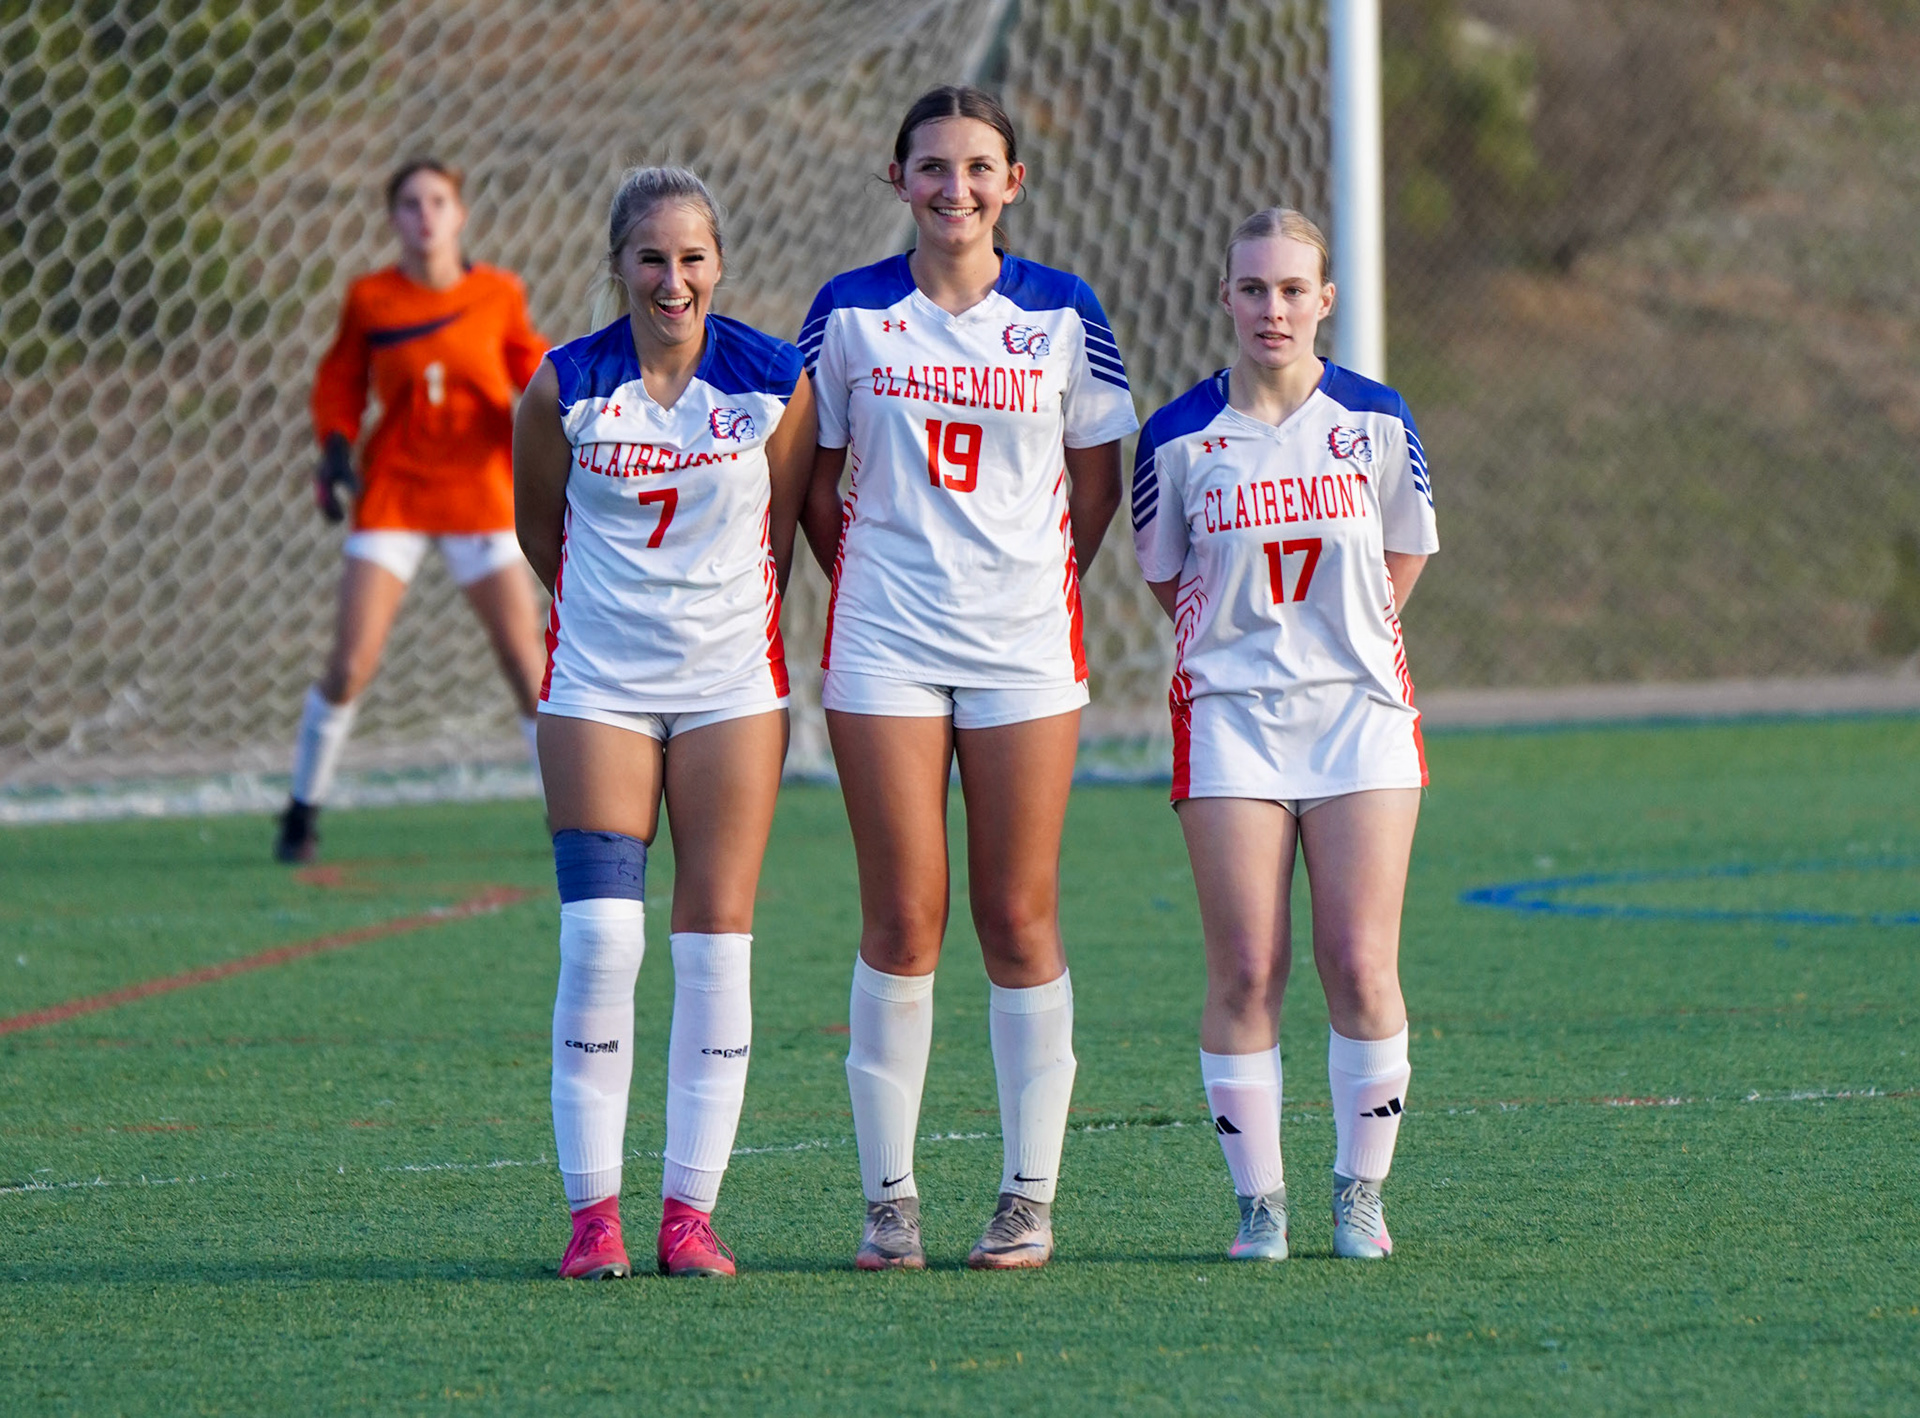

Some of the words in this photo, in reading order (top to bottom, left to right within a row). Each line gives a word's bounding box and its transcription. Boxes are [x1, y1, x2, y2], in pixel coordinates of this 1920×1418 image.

[424, 360, 445, 407] 1
[872, 366, 1043, 413] CLAIREMONT
[925, 418, 983, 493] 19
[638, 488, 679, 548] 7
[1204, 473, 1367, 533] CLAIREMONT
[1263, 537, 1323, 605] 17
